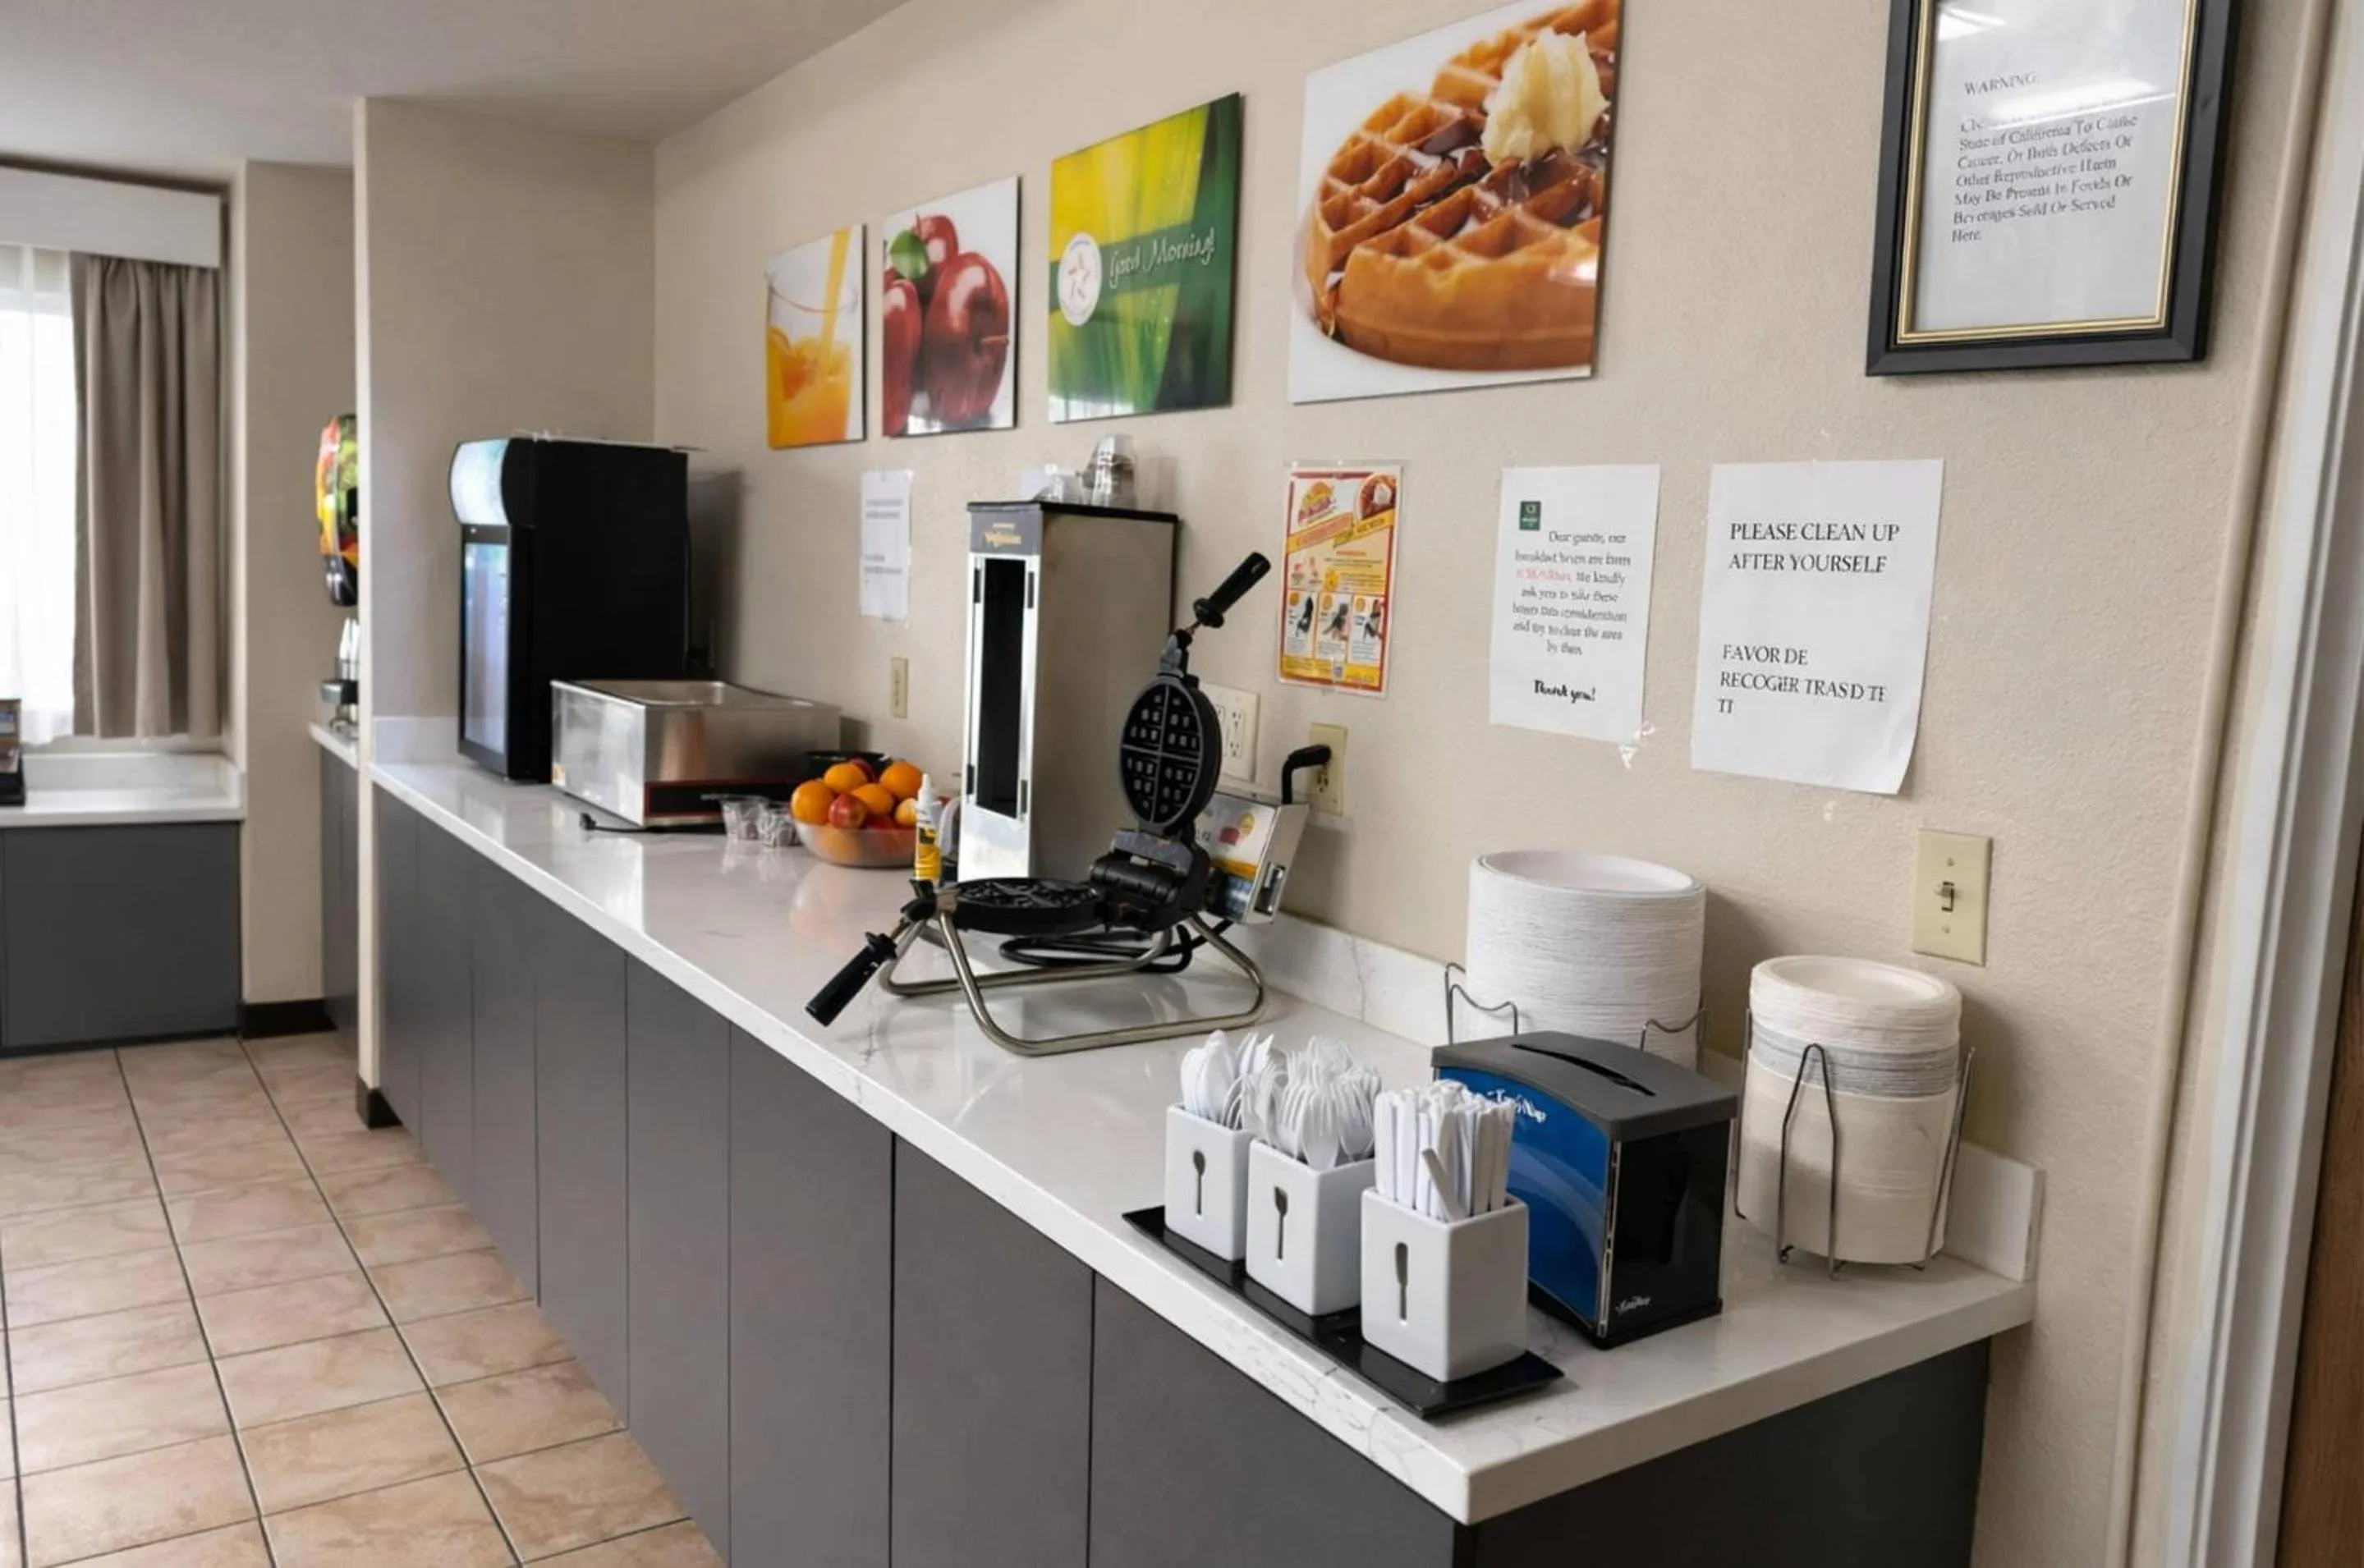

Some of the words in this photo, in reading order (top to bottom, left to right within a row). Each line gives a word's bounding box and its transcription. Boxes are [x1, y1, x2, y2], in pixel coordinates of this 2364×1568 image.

[2073, 120, 2092, 134] To
[2115, 134, 2132, 149] Or
[1985, 189, 2002, 202] Be
[2114, 173, 2133, 187] Or
[2051, 201, 2067, 214] Or
[1730, 522, 1797, 541] PLEASE
[1801, 522, 1866, 542] CLEAN
[1872, 523, 1900, 542] UP
[1728, 553, 1784, 571] AFTER
[1789, 553, 1888, 573] YOURSELF
[1723, 644, 1780, 663] FAVOR
[1784, 647, 1809, 666] DE
